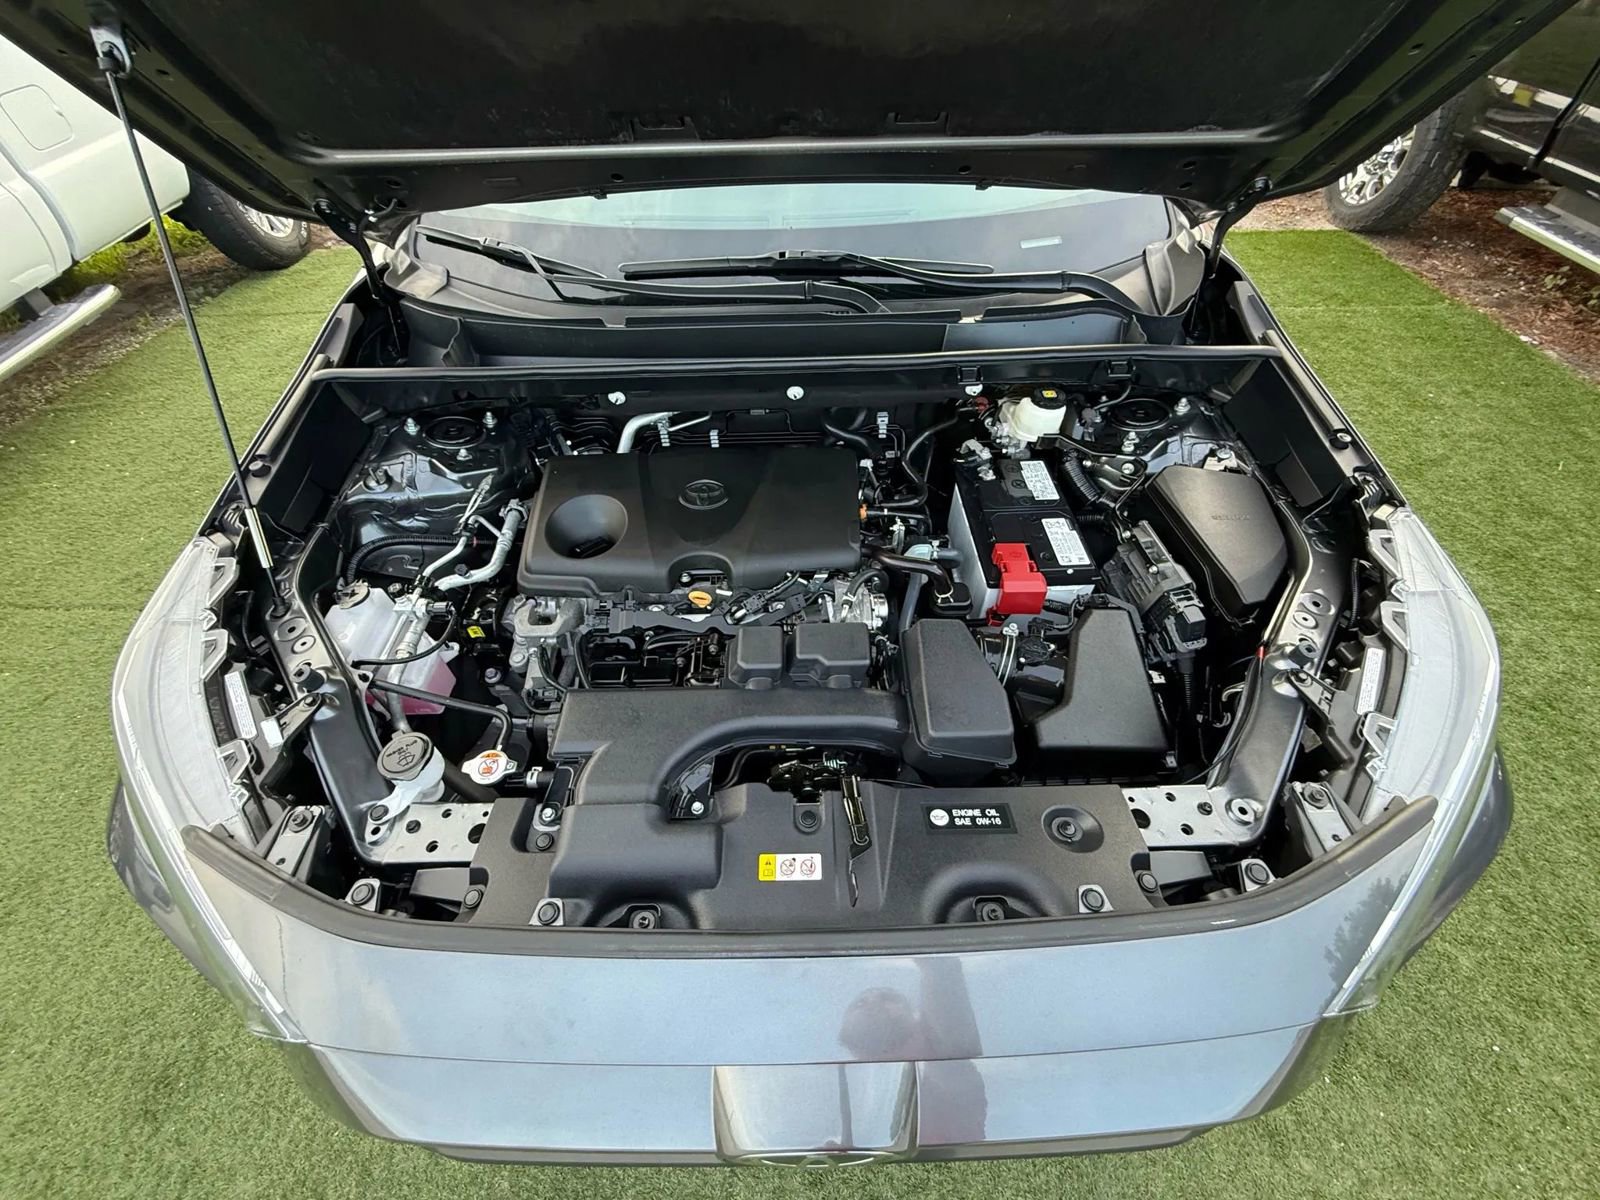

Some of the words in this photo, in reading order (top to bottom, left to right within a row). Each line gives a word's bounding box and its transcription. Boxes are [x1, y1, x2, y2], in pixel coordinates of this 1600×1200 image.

[952, 808, 982, 817] ENGINE
[985, 808, 999, 817] OIL
[954, 817, 972, 826] SAE
[975, 817, 1002, 826] 0W-16
